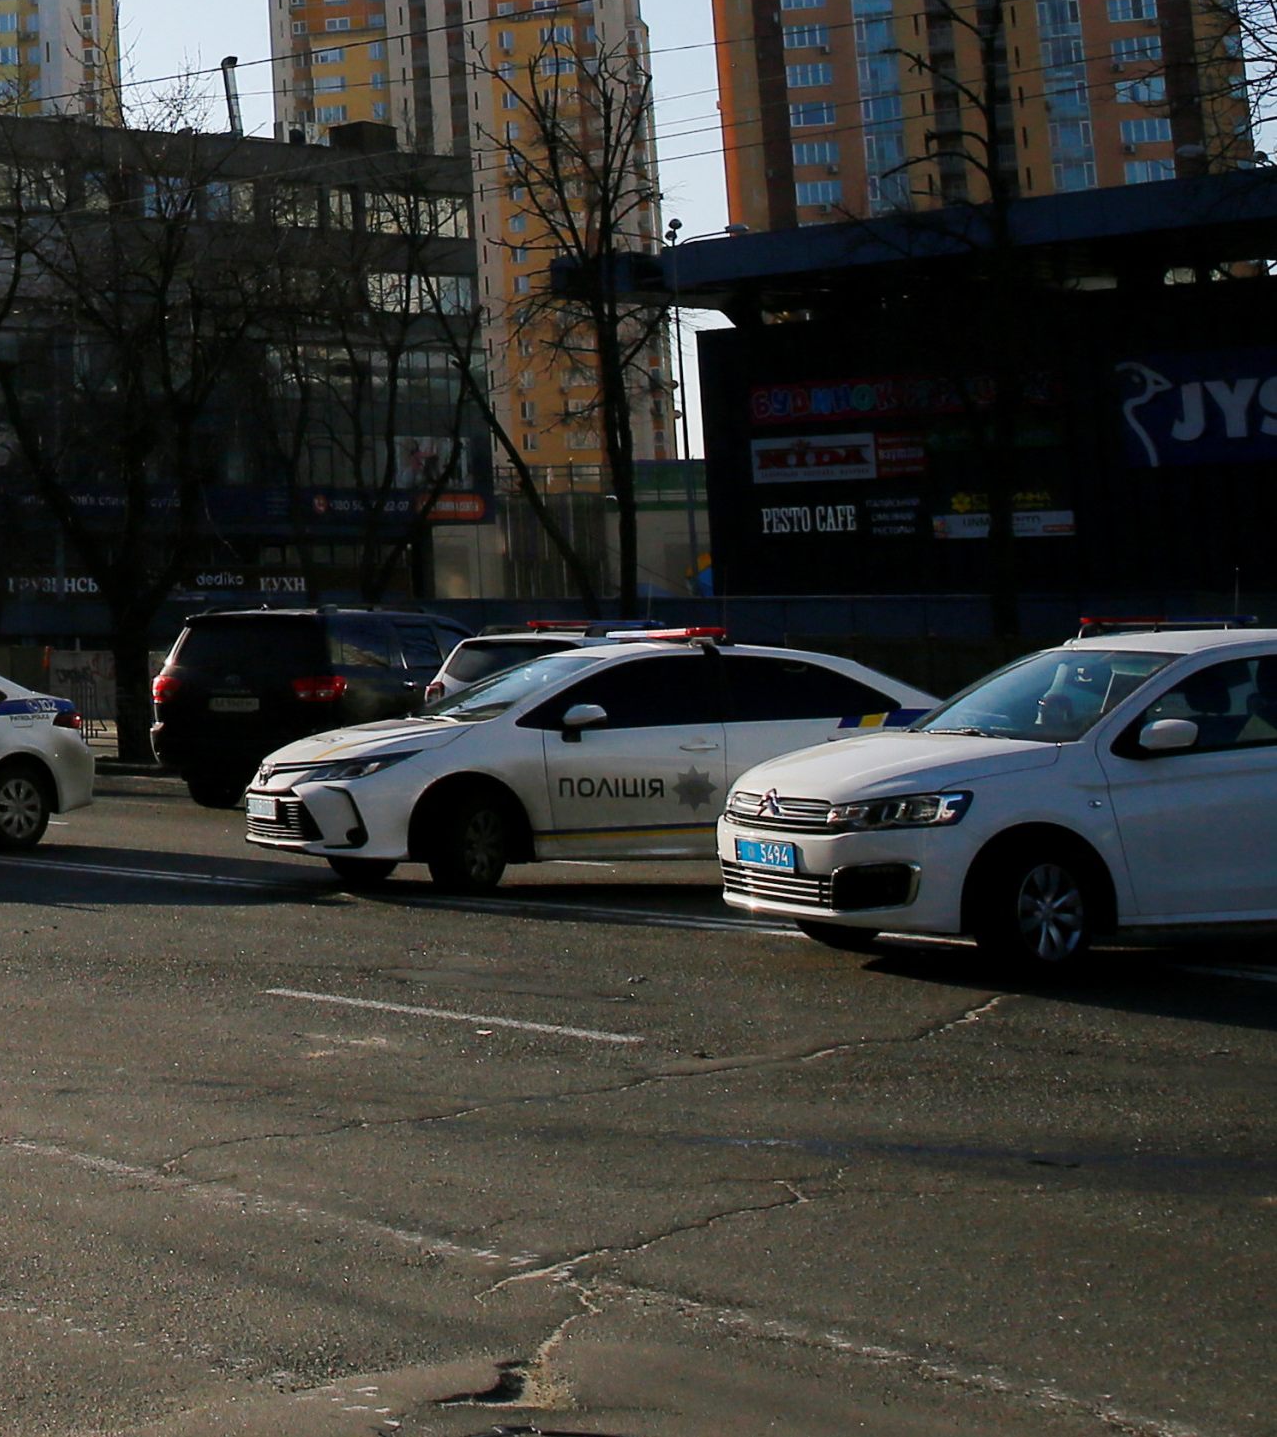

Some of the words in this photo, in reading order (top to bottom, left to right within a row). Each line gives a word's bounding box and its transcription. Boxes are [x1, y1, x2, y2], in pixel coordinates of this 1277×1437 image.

[760, 506, 813, 534] PESTO
[815, 504, 857, 532] CAFE
[196, 571, 244, 586] dediko
[259, 577, 306, 592] КУХН
[38, 700, 57, 711] 102
[558, 778, 664, 798] ПОЛІЦІЯ
[760, 843, 788, 866] 5494
